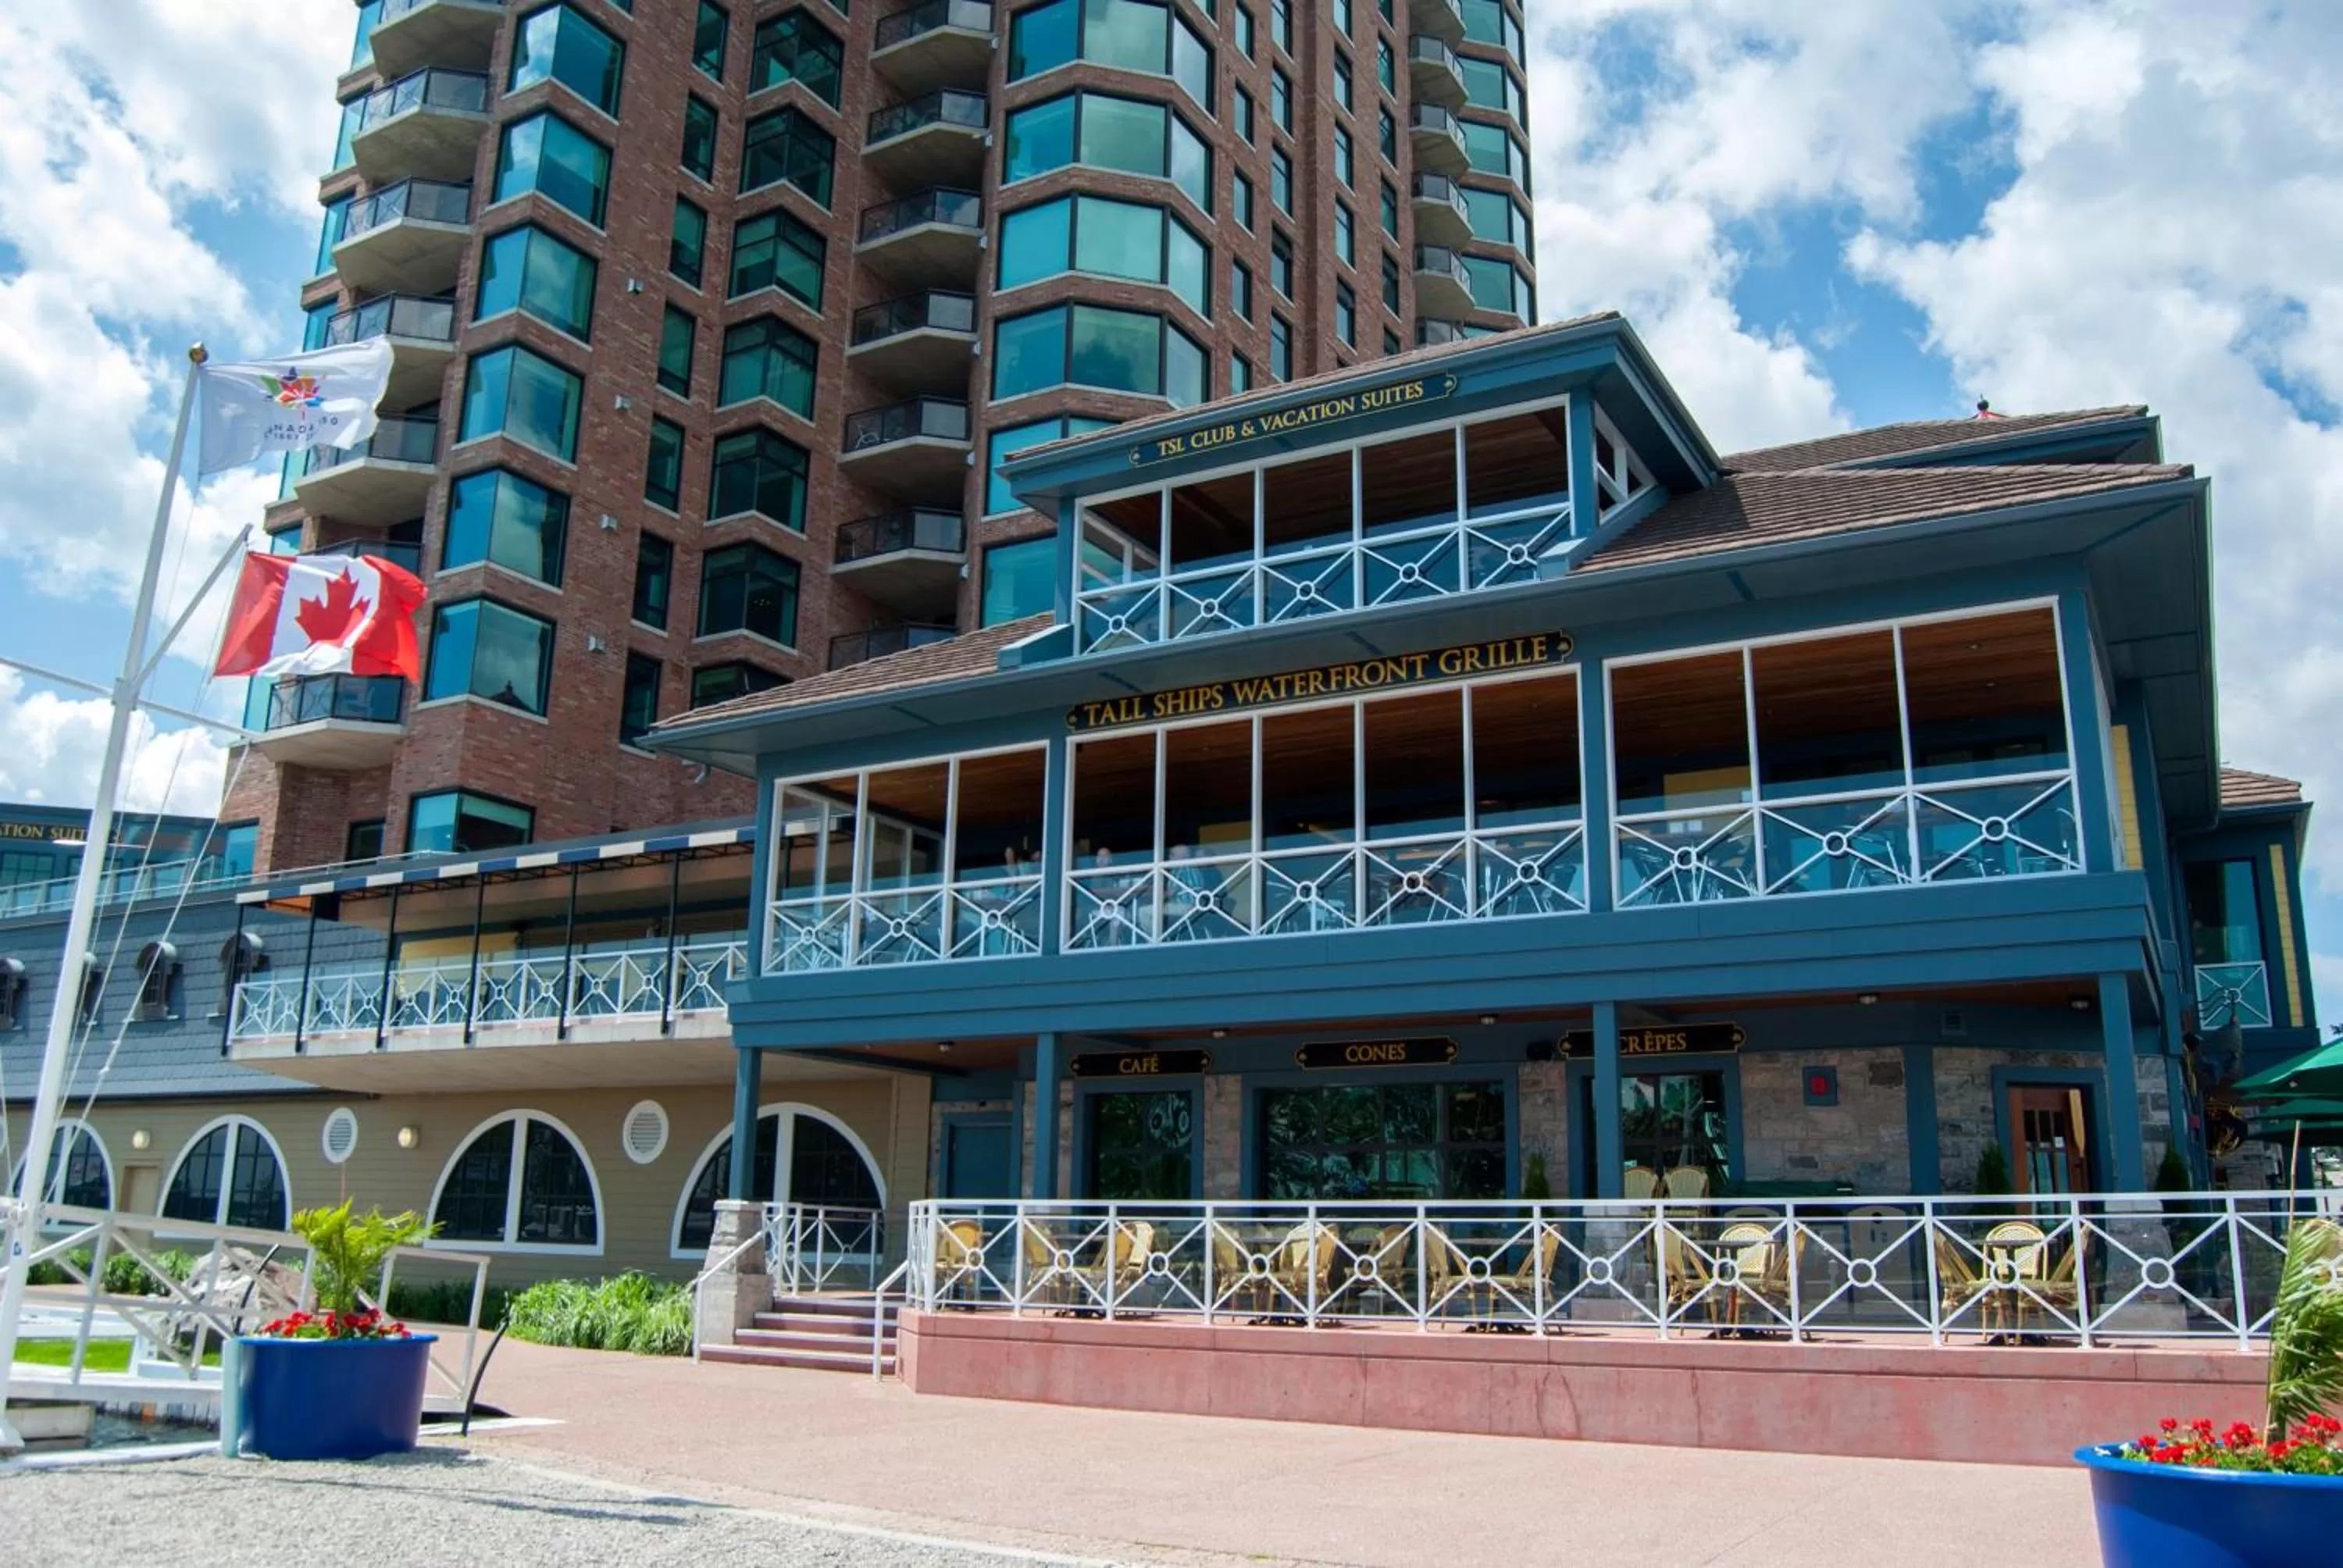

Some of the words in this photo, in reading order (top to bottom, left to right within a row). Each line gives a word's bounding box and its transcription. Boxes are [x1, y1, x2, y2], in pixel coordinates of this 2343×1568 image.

[1157, 437, 1186, 456] TSL
[1191, 424, 1236, 449] CLUB
[1241, 420, 1257, 437] &
[1259, 397, 1355, 432] VACATION
[1361, 381, 1425, 409] SUITES
[1083, 697, 1146, 727] TALL
[1152, 684, 1224, 717] SHIPS
[1232, 653, 1428, 704] WATERFRONT
[1439, 636, 1548, 675] GRILLE
[0, 823, 44, 839] TION
[49, 825, 87, 841] SUIT
[1345, 1043, 1407, 1062] CONES
[1118, 1054, 1160, 1074] CAFÉ
